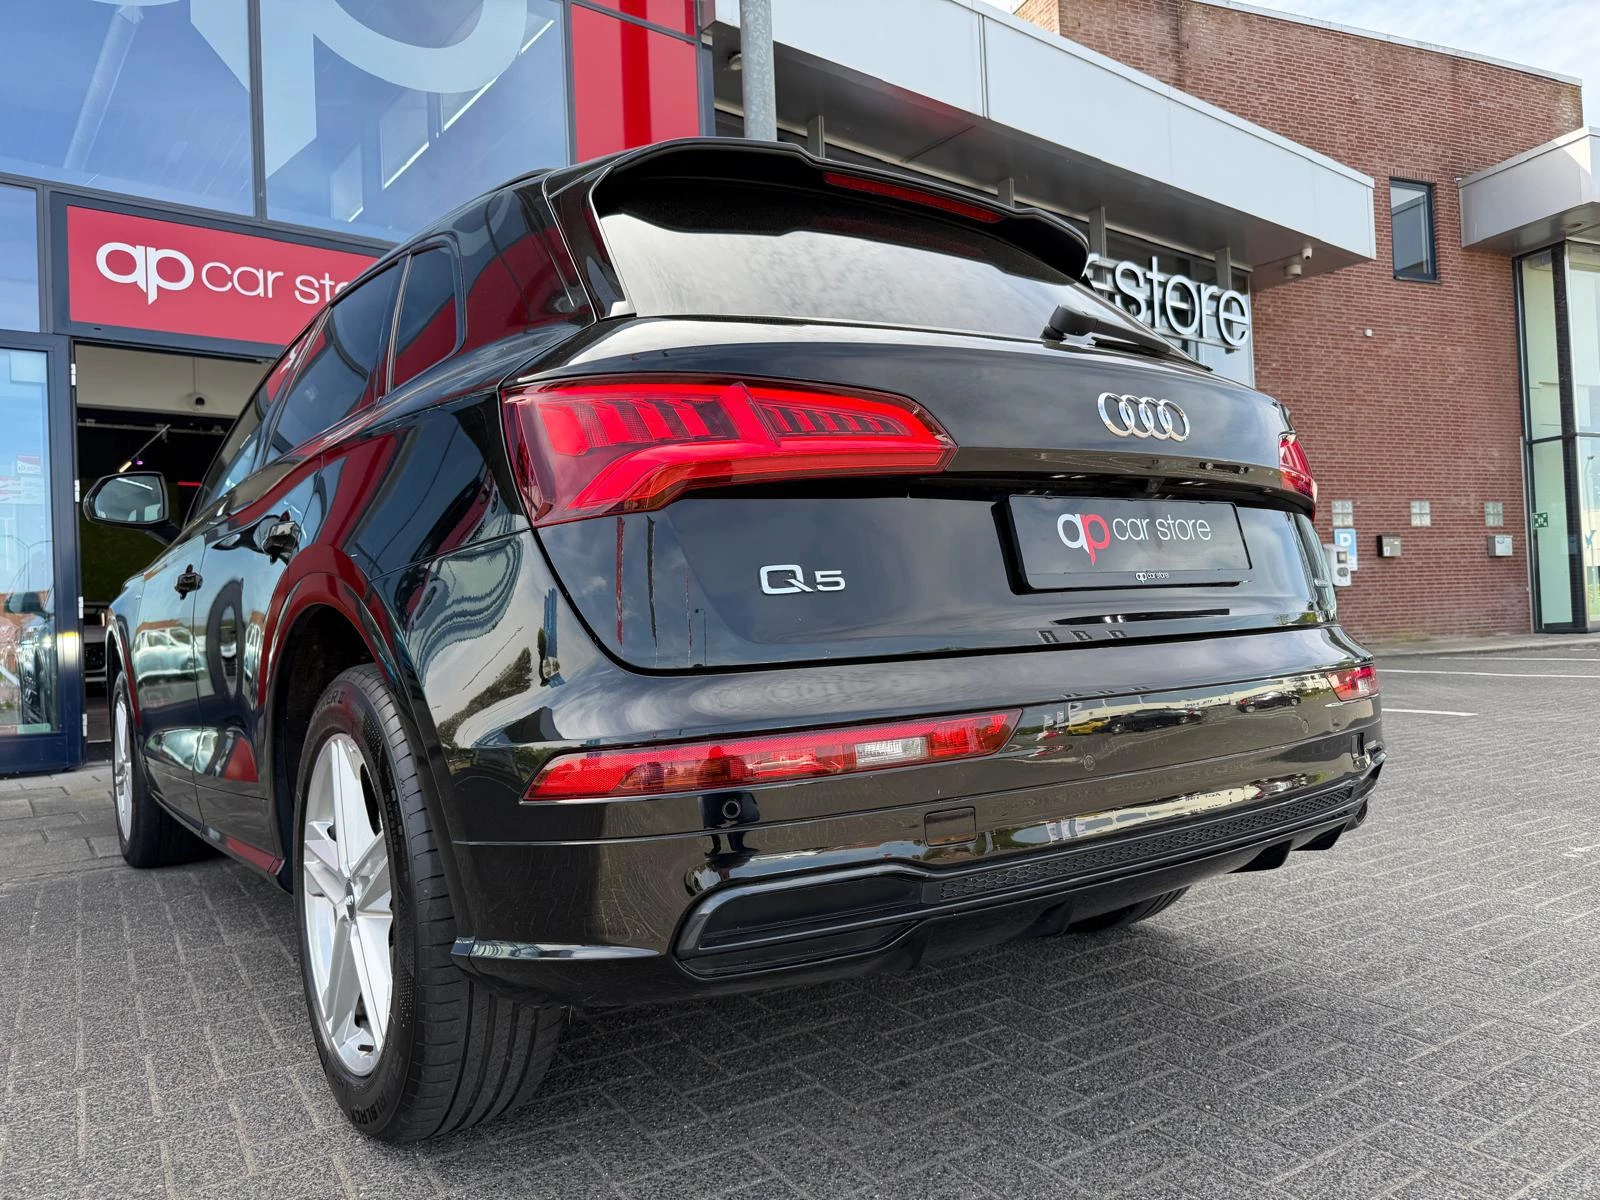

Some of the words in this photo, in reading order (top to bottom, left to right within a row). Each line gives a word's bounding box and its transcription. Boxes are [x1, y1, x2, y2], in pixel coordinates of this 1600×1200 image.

[96, 241, 195, 305] ap
[201, 261, 284, 298] car
[1115, 255, 1250, 347] store
[1057, 513, 1111, 566] ap
[1112, 517, 1149, 541] car
[1156, 515, 1212, 541] store
[759, 564, 846, 595] Q5
